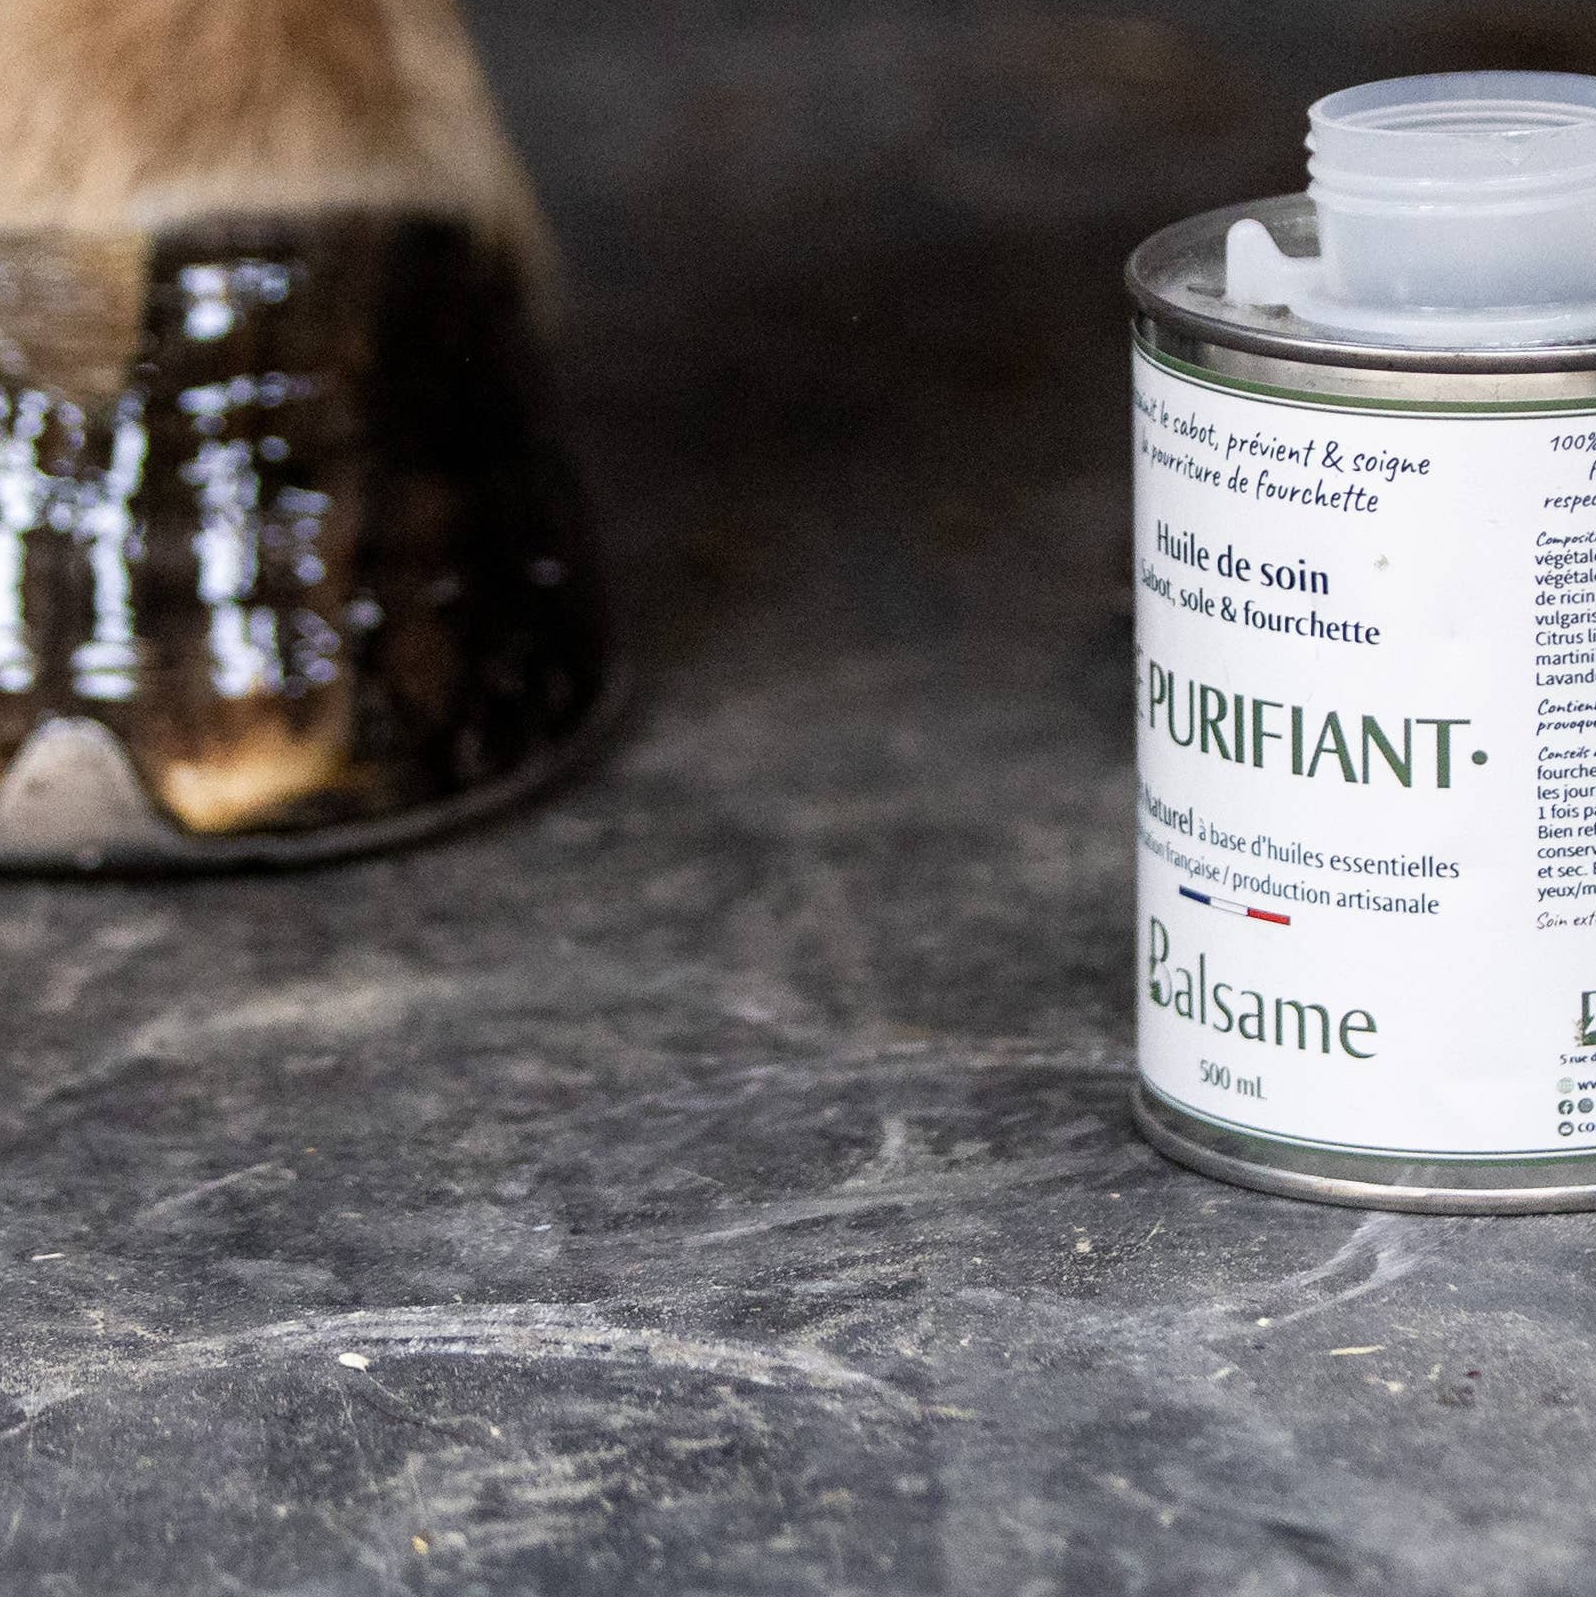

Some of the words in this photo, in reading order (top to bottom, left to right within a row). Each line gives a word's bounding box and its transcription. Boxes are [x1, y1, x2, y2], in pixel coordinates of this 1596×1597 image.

[1160, 400, 1169, 428] le
[1174, 413, 1218, 451] sabot,
[1227, 432, 1315, 466] prévient
[1322, 441, 1344, 472] &
[1353, 450, 1431, 482] soigne
[1152, 444, 1221, 486] pourriture
[1228, 465, 1248, 492] de
[1256, 470, 1378, 512] fourchette
[1157, 520, 1209, 571] Huile
[1218, 545, 1251, 582] de
[1261, 559, 1329, 595] soin
[1535, 591, 1555, 605] de
[1180, 588, 1214, 616] sole
[1221, 597, 1237, 622] &
[1245, 600, 1380, 645] fourchette
[1535, 629, 1583, 646] Citrus
[1537, 785, 1560, 800] les
[1538, 806, 1545, 819] 1
[1551, 802, 1580, 819] fois
[1538, 826, 1573, 839] Bien
[1199, 812, 1207, 840] à
[1211, 823, 1246, 853] base
[1251, 834, 1323, 868] d'huiles
[1331, 855, 1460, 879] essentielles
[1538, 865, 1552, 878] et
[1233, 870, 1330, 905] production
[1336, 890, 1440, 915] artisanale
[1537, 911, 1568, 929] Soin
[1150, 915, 1378, 1058] Balsame
[1560, 1054, 1567, 1065] 5
[1570, 1054, 1587, 1063] rue
[1200, 1059, 1230, 1090] 500
